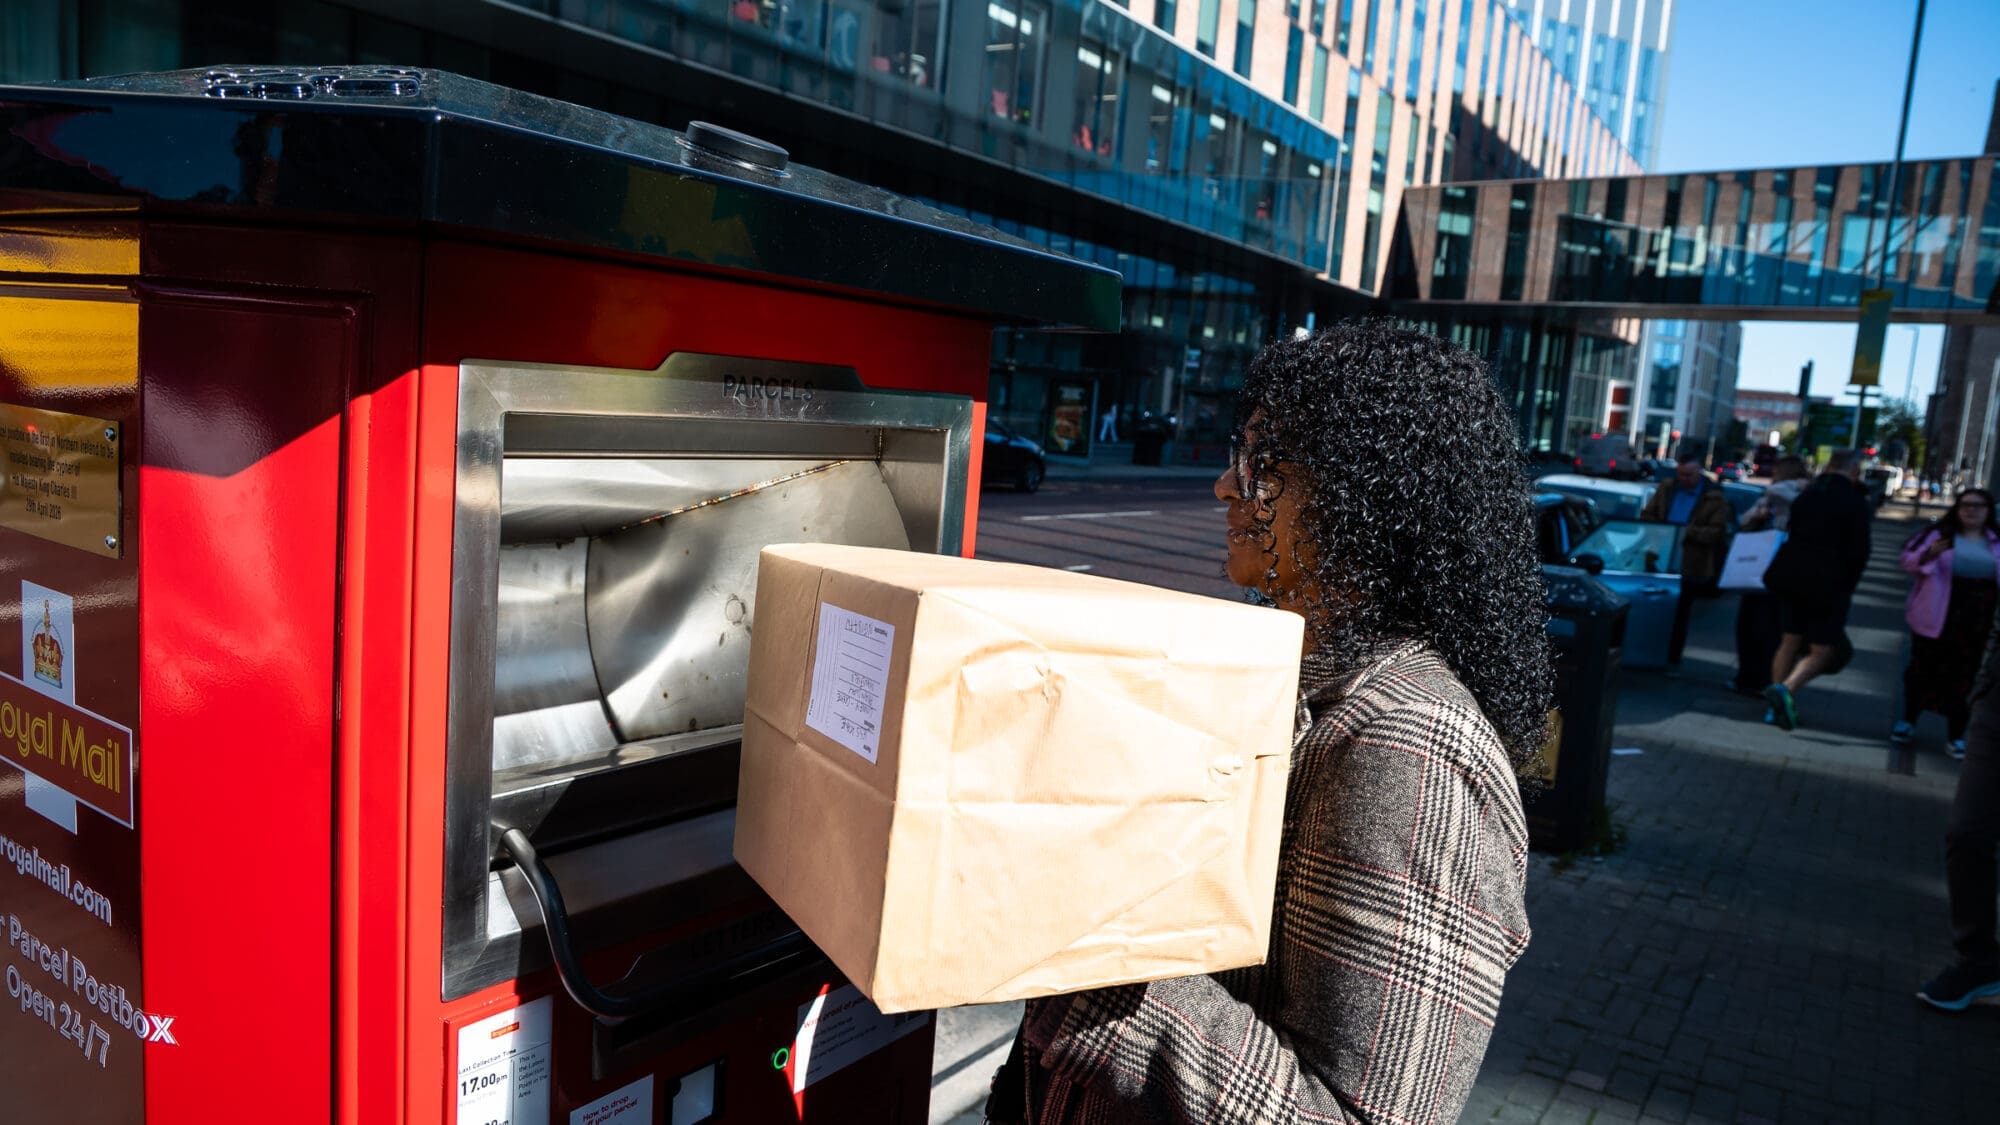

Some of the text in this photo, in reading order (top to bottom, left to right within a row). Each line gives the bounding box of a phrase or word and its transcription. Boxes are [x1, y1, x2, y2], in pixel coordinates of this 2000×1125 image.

[723, 374, 814, 401] PARCELS
[40, 431, 49, 446] first
[21, 473, 38, 496] Majesty
[39, 478, 49, 497] King
[51, 480, 70, 498] Charles
[37, 501, 48, 520] April
[0, 701, 120, 793] oyal Mail
[0, 834, 112, 927] royalmail.com
[9, 912, 179, 1046] Parcel Postbox
[6, 964, 110, 1068] Open 24/7
[459, 1049, 516, 1075] Last Collection Time
[583, 1095, 629, 1122] How to drop
[595, 1112, 613, 1125] your
[614, 1099, 638, 1116] parcel
